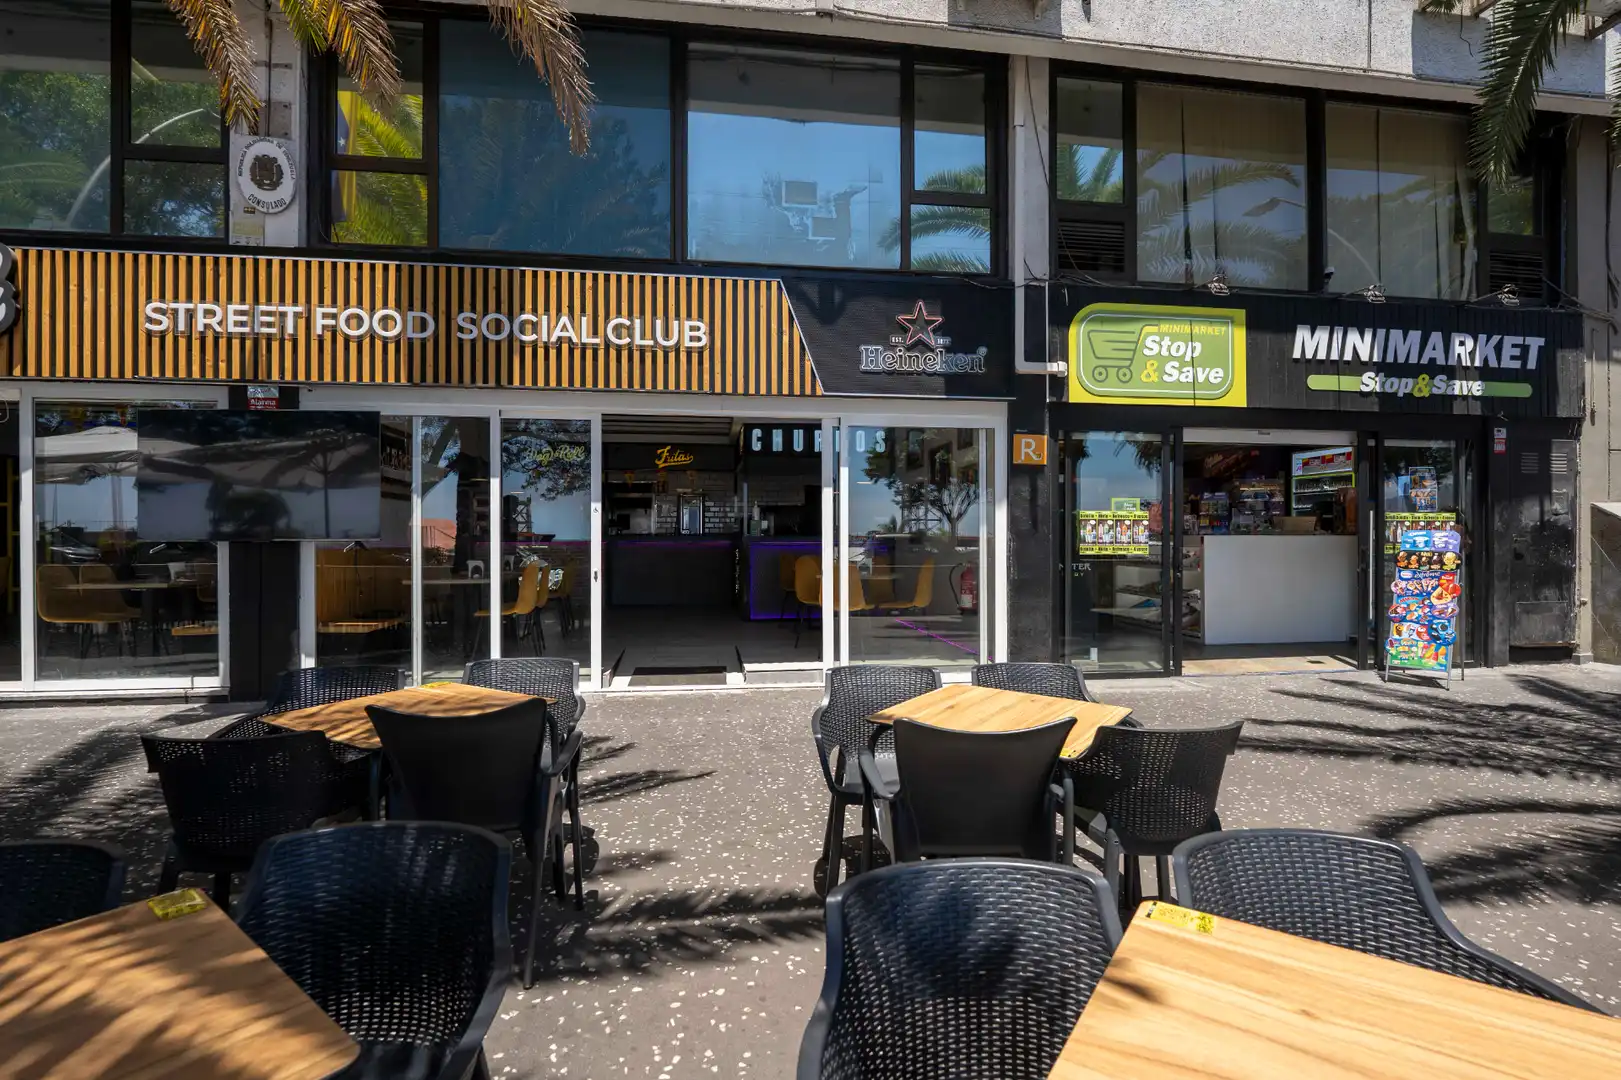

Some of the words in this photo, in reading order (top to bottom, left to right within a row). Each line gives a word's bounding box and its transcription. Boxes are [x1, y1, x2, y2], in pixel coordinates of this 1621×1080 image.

[247, 193, 287, 210] CONSULADO
[144, 302, 304, 335] STREET
[315, 307, 436, 339] FOOD
[456, 312, 601, 344] SOCIAL
[606, 317, 709, 348] CLUB
[1160, 324, 1226, 337] MINIMARKET
[861, 346, 986, 374] Heineken
[1142, 334, 1202, 362] Stop
[1293, 324, 1546, 371] MINIMARKET
[1140, 360, 1159, 383] &
[1162, 360, 1225, 384] Save
[655, 445, 694, 469] Fritas
